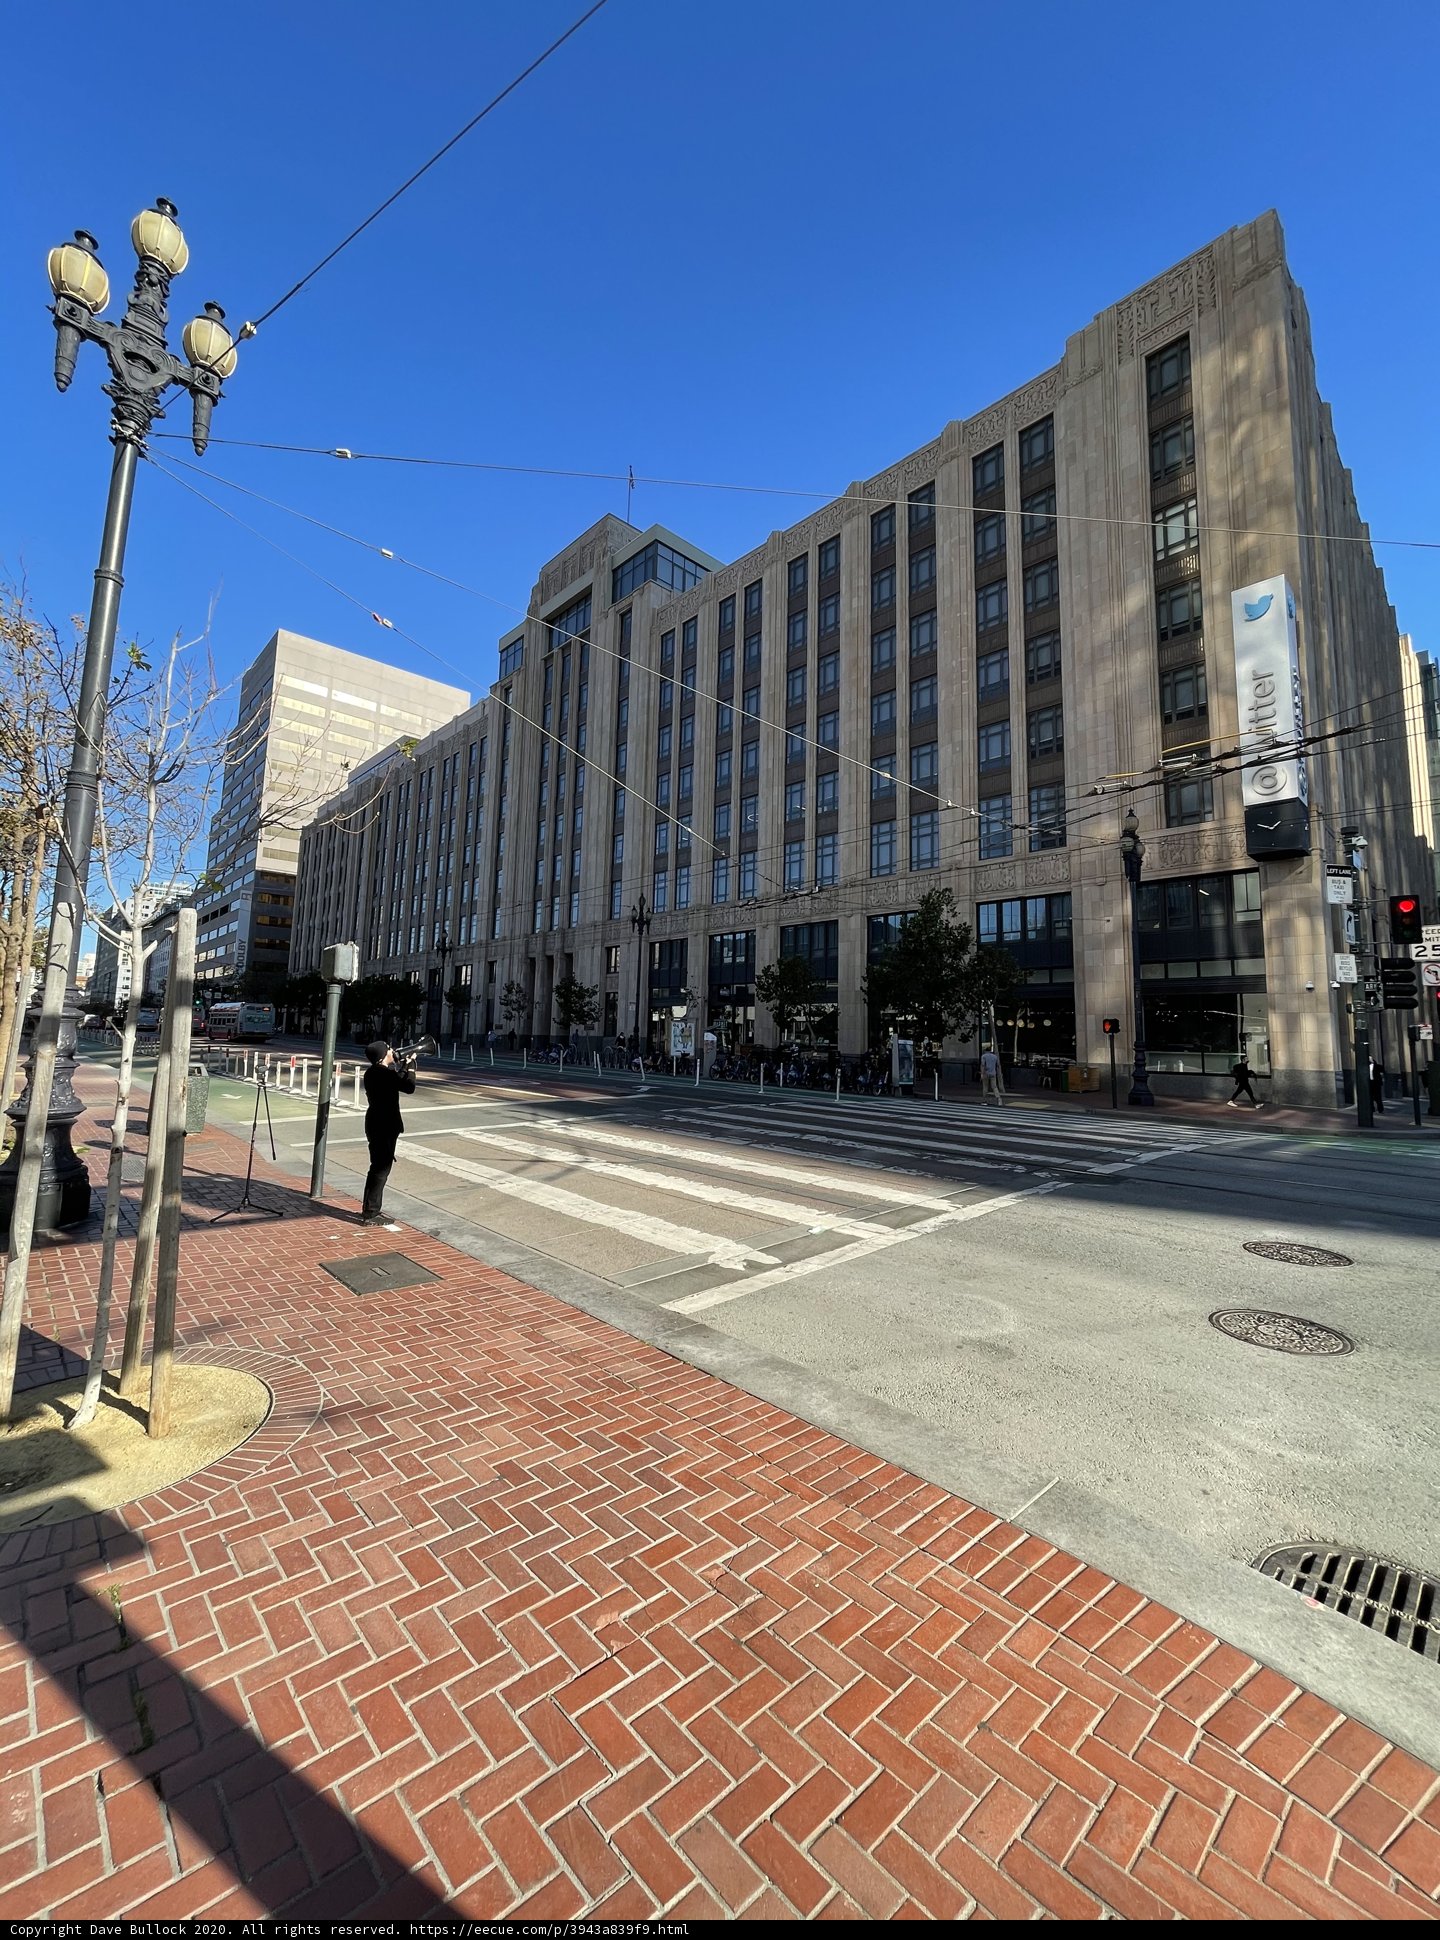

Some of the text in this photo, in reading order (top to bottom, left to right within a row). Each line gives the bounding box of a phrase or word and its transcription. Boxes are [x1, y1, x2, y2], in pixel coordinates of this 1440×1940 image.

[1248, 669, 1288, 796] @witter
[236, 938, 247, 968] DOLBY
[1414, 945, 1440, 957] 25
